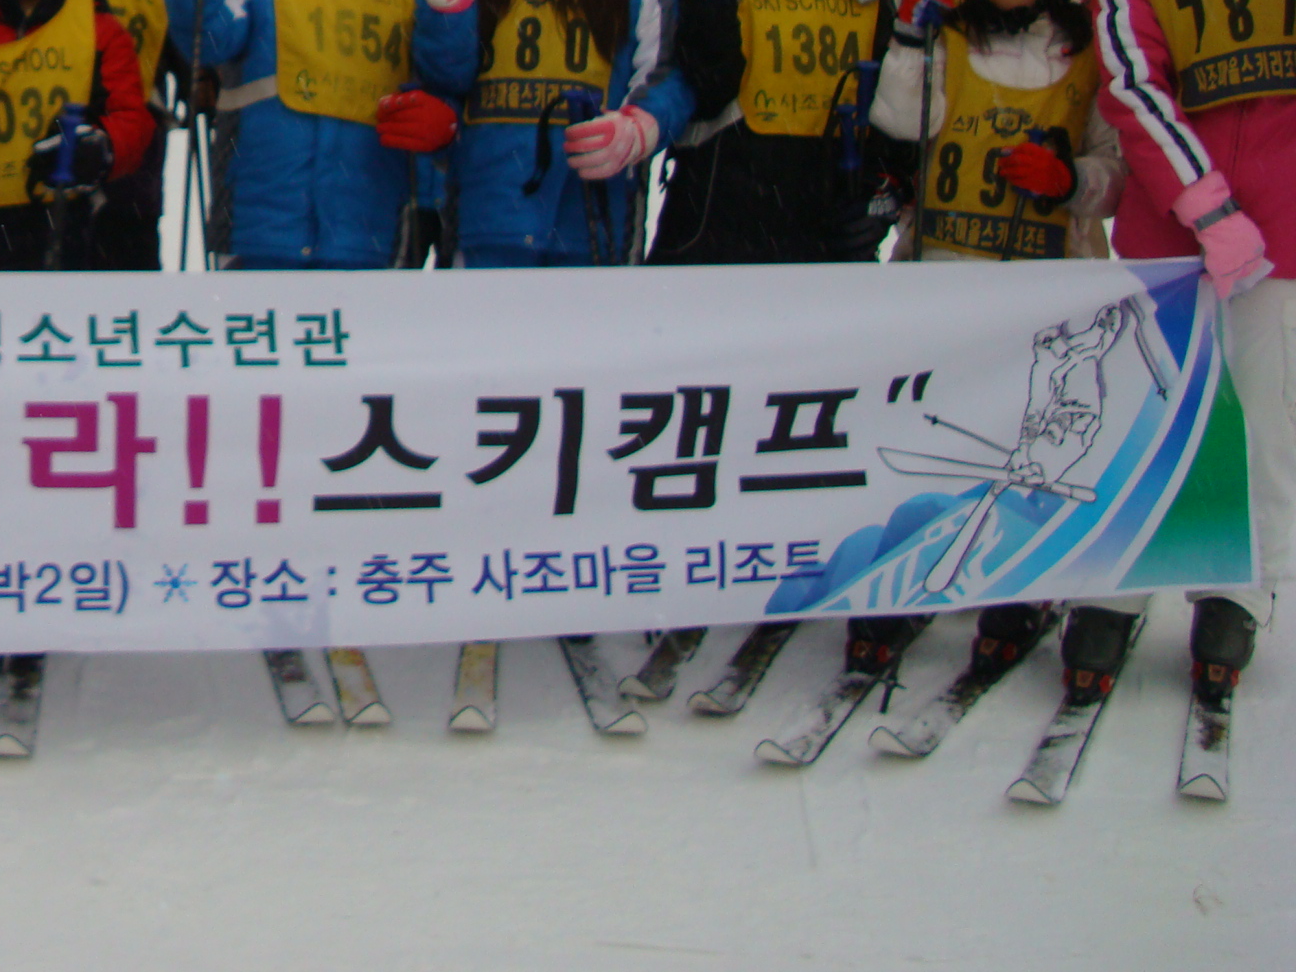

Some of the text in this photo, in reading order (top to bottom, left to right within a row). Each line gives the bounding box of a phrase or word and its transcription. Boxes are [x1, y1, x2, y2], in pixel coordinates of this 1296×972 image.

[765, 22, 860, 76] 1384
[953, 115, 980, 137] 스키
[210, 557, 310, 611] 장소
[356, 552, 455, 607] 충주
[471, 542, 668, 602] 사조마을
[685, 539, 826, 590] 리조트
